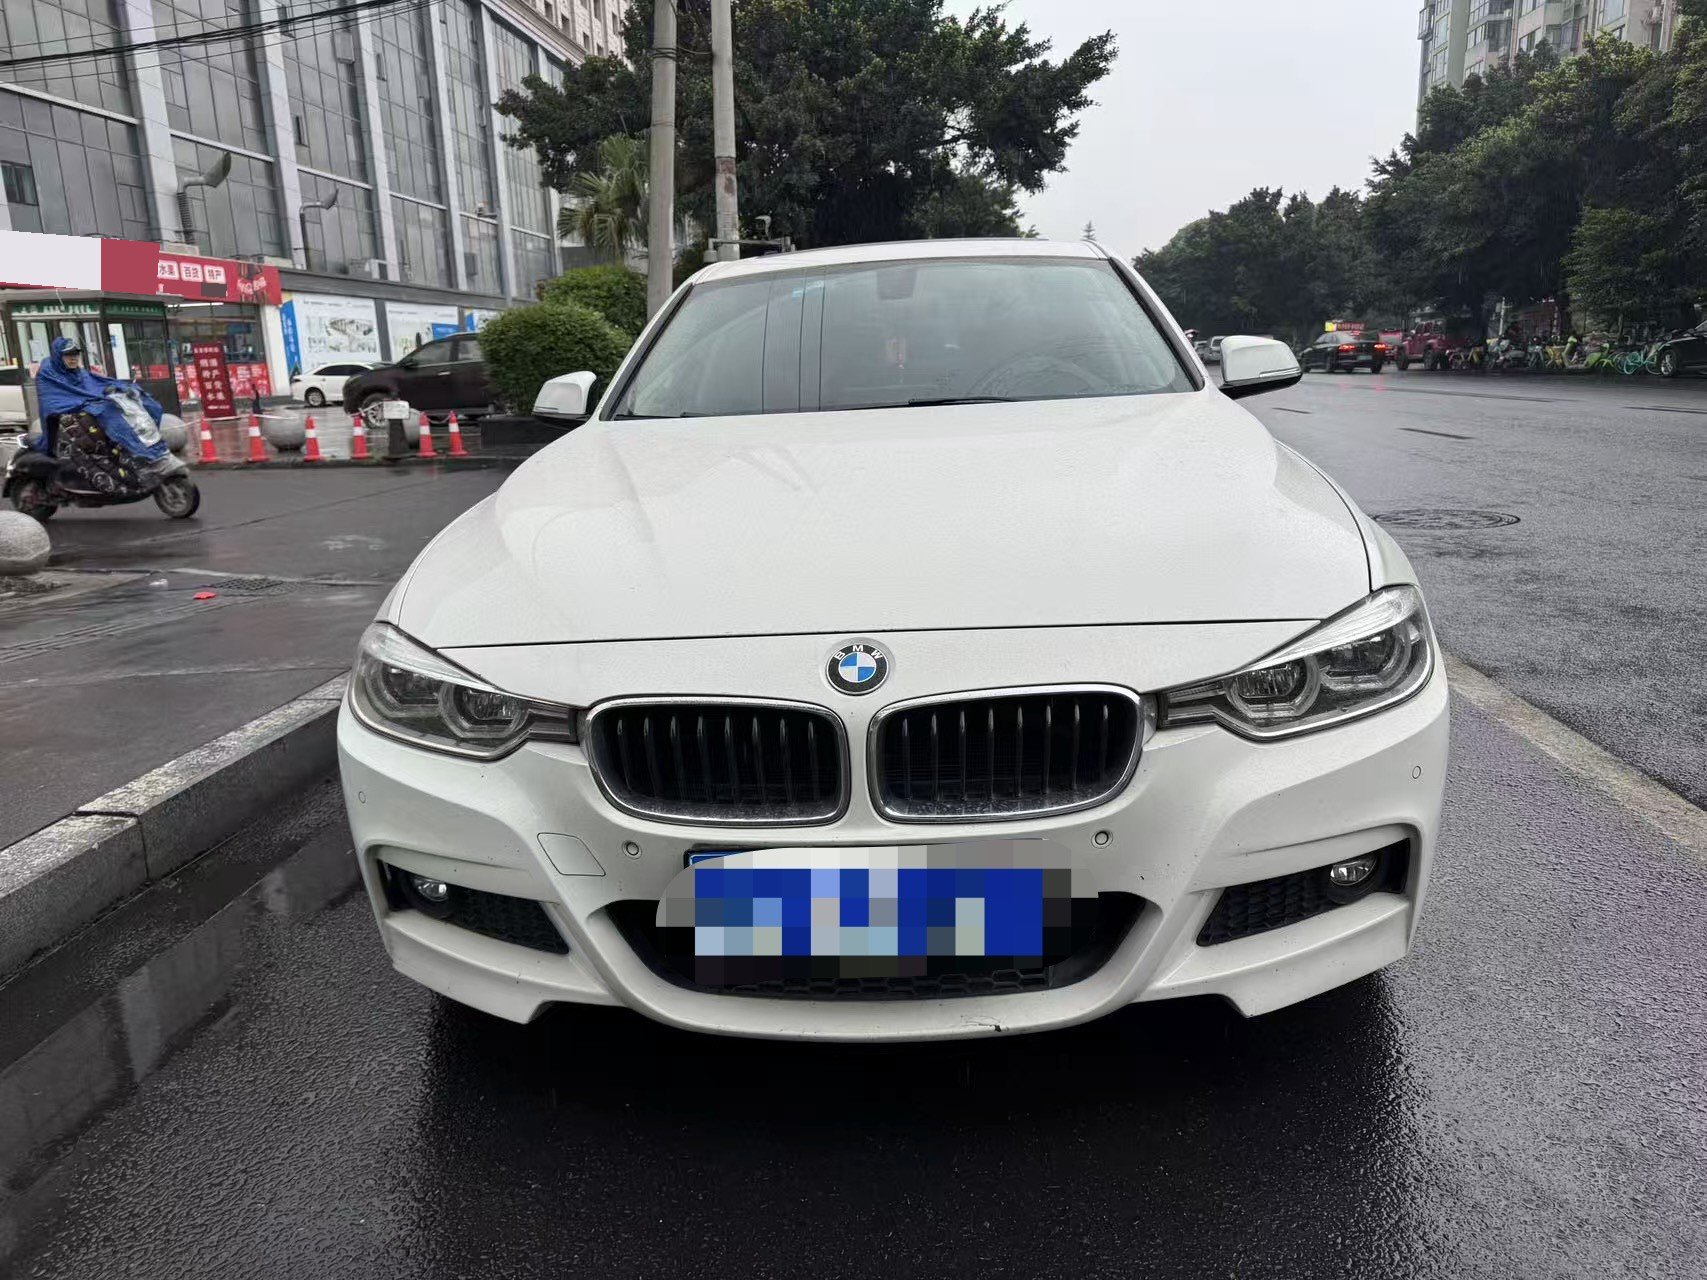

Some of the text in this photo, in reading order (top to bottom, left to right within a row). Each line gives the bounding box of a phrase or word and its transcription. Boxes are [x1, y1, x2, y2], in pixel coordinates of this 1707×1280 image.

[159, 264, 222, 280] 水果 百货 特产
[834, 645, 883, 660] BMW
